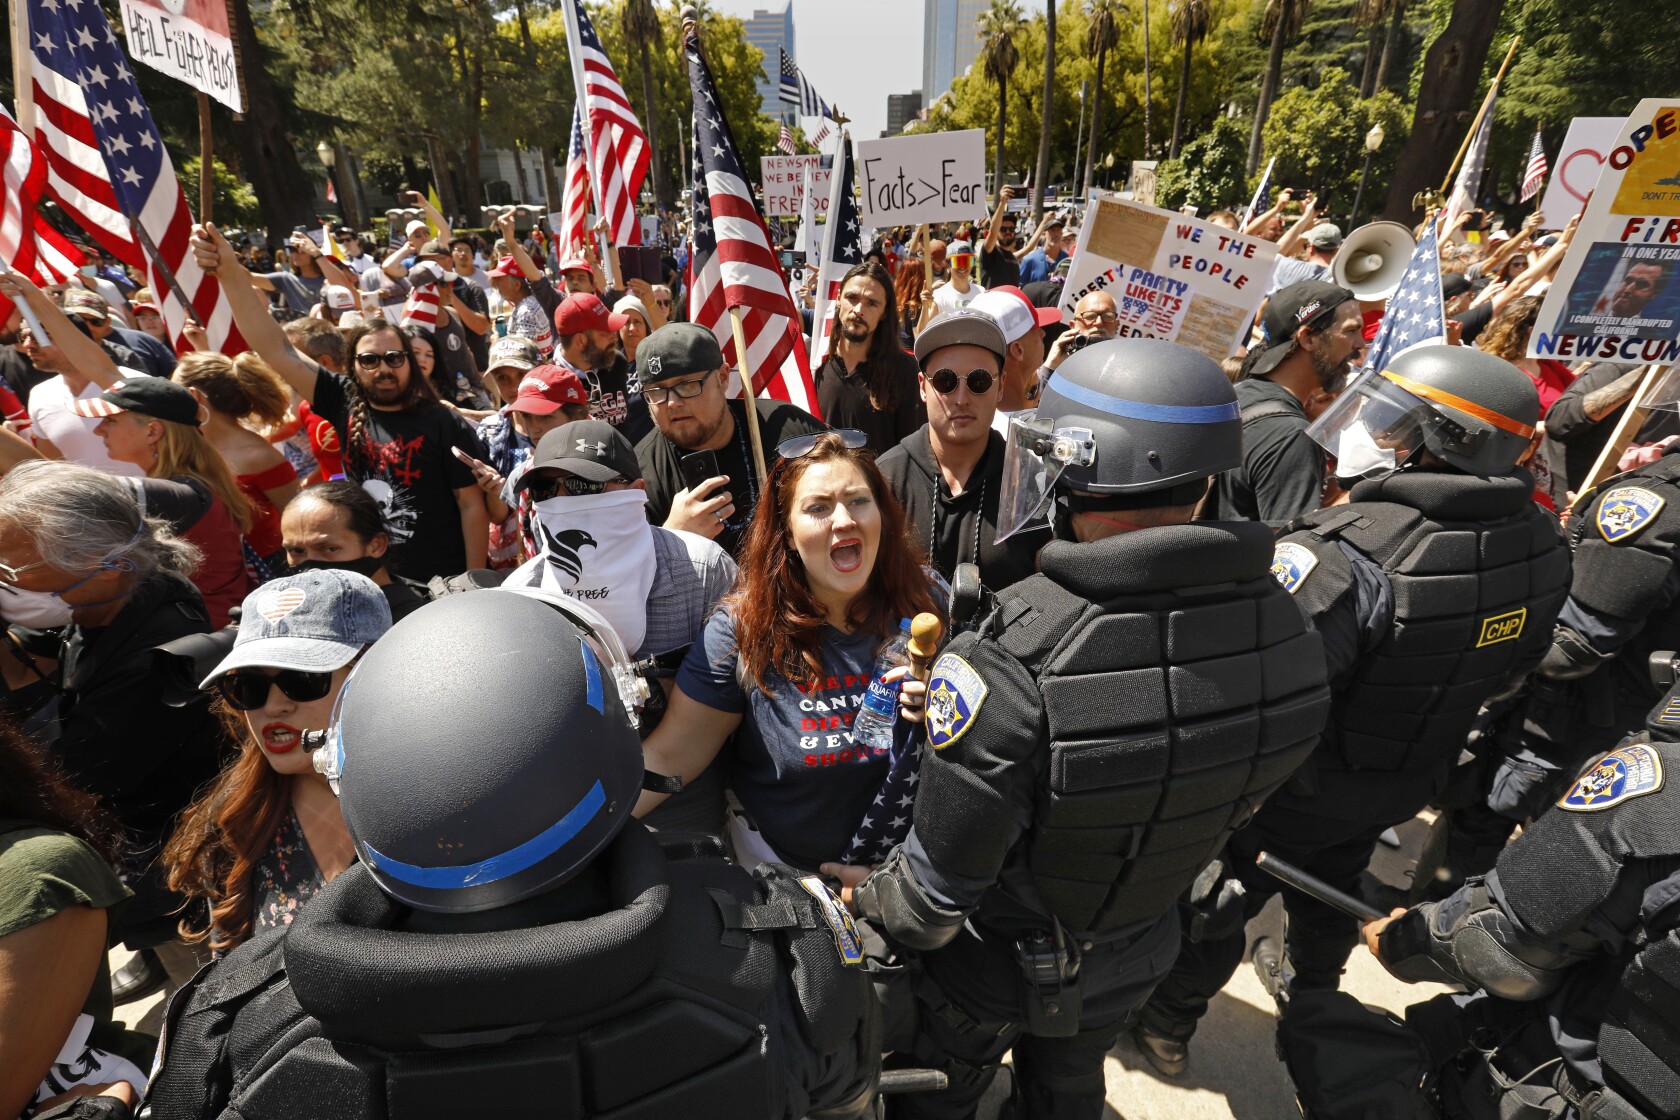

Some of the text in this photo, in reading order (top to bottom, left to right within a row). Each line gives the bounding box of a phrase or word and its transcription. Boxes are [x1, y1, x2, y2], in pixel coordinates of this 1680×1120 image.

[1609, 111, 1680, 170] OPE
[765, 171, 831, 184] WE BEIEV
[793, 185, 804, 198] IN
[1642, 192, 1680, 200] DONT TR
[769, 196, 830, 214] FREDO
[1620, 217, 1680, 243] FiR
[1177, 224, 1257, 259] WE THE
[1621, 247, 1680, 260] IN ONE YEA
[1169, 254, 1249, 290] PEOPLE
[1130, 268, 1189, 297] PARTY
[1125, 283, 1183, 311] LIKE IT'S
[1119, 296, 1176, 334] 1776
[1570, 315, 1673, 329] I COMPLETELY BANKRUPTED
[1593, 325, 1639, 336] CALIFORNIA
[491, 340, 526, 352] RUMP
[1487, 618, 1520, 639] CHP
[868, 680, 899, 699] AQUAFIN
[799, 695, 847, 712] CAN
[850, 692, 866, 707] M
[801, 713, 858, 731] DIFF
[799, 731, 855, 749] & EV
[804, 744, 890, 767] SHOU
